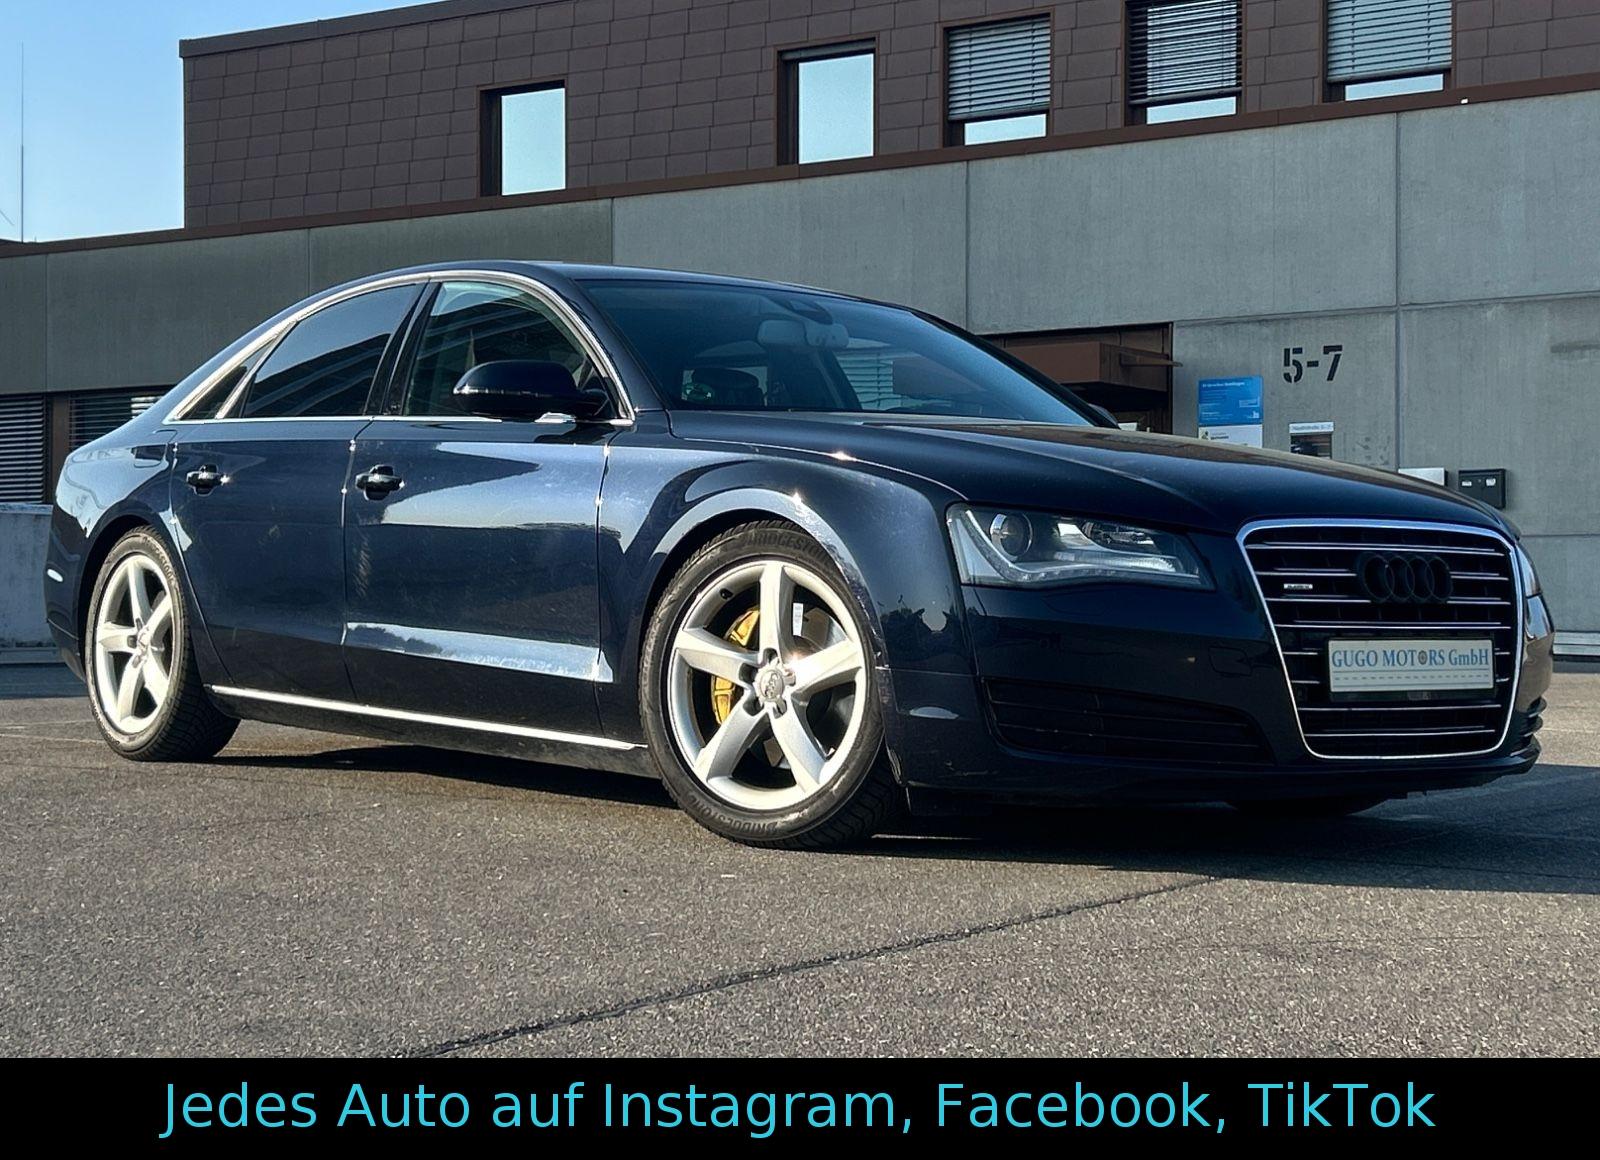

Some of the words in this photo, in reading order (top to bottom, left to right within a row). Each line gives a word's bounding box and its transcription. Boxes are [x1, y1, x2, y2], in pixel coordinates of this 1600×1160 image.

[1283, 345, 1342, 383] 5-7
[1332, 649, 1378, 668] GUGO
[1382, 649, 1445, 667] MOTORS
[1448, 648, 1489, 666] GmbH
